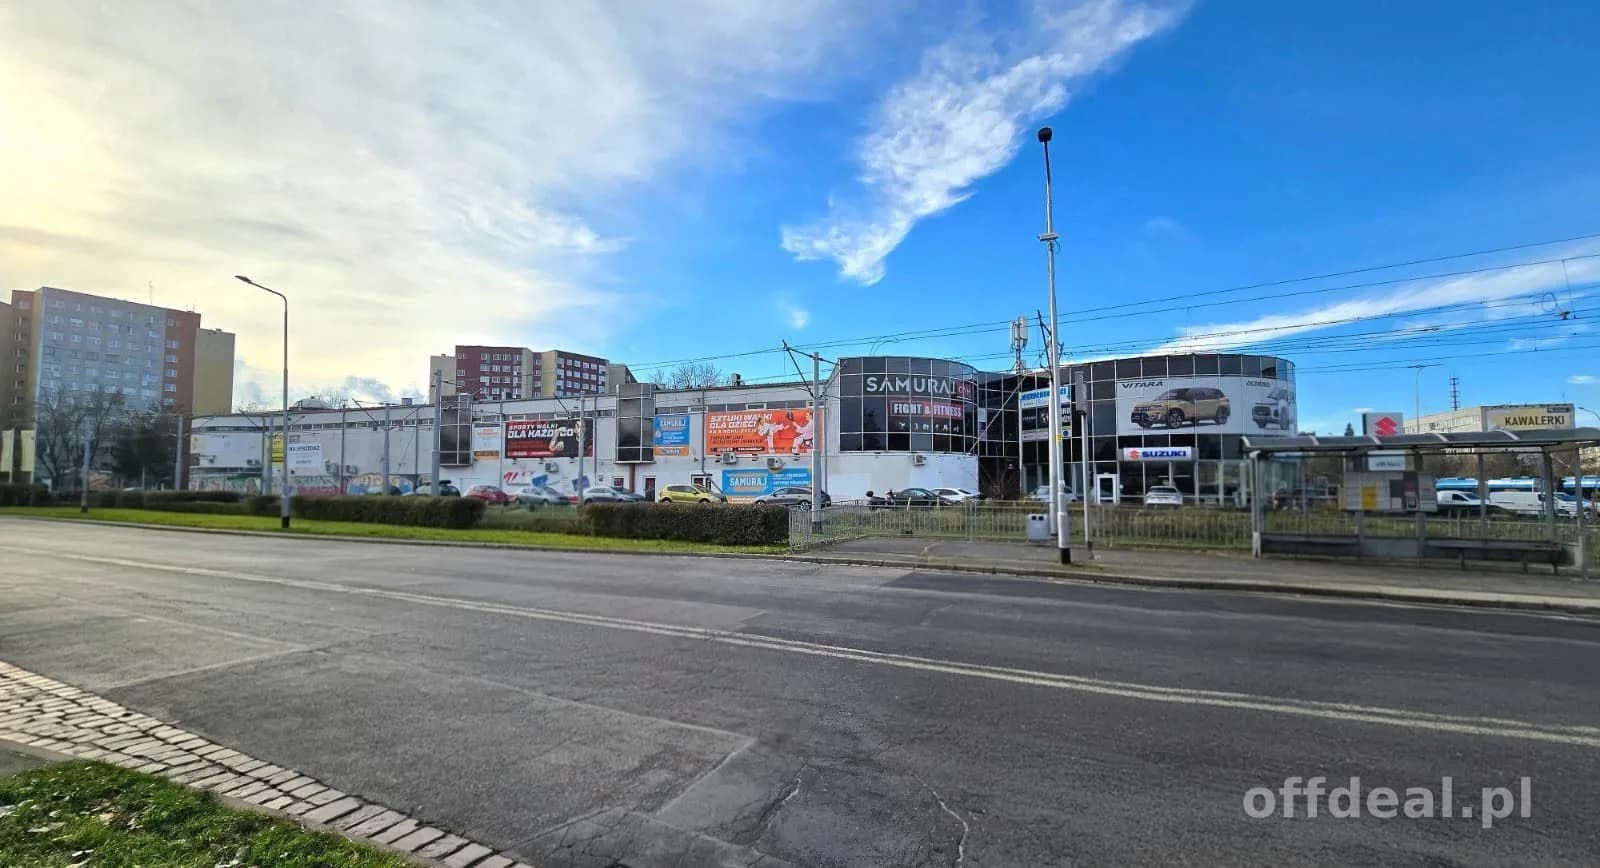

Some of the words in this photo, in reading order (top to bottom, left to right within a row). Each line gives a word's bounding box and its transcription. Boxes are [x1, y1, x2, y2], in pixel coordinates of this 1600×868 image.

[866, 377, 956, 394] SAMURAI
[1122, 381, 1164, 389] VITARA
[893, 403, 922, 414] FIGHT
[934, 405, 962, 417] FITNESS
[709, 421, 726, 429] DLA
[728, 420, 757, 428] DZIECI
[1504, 415, 1565, 426] KAWALERKI
[507, 429, 526, 439] DLA
[729, 477, 767, 488] SAMURAJ
